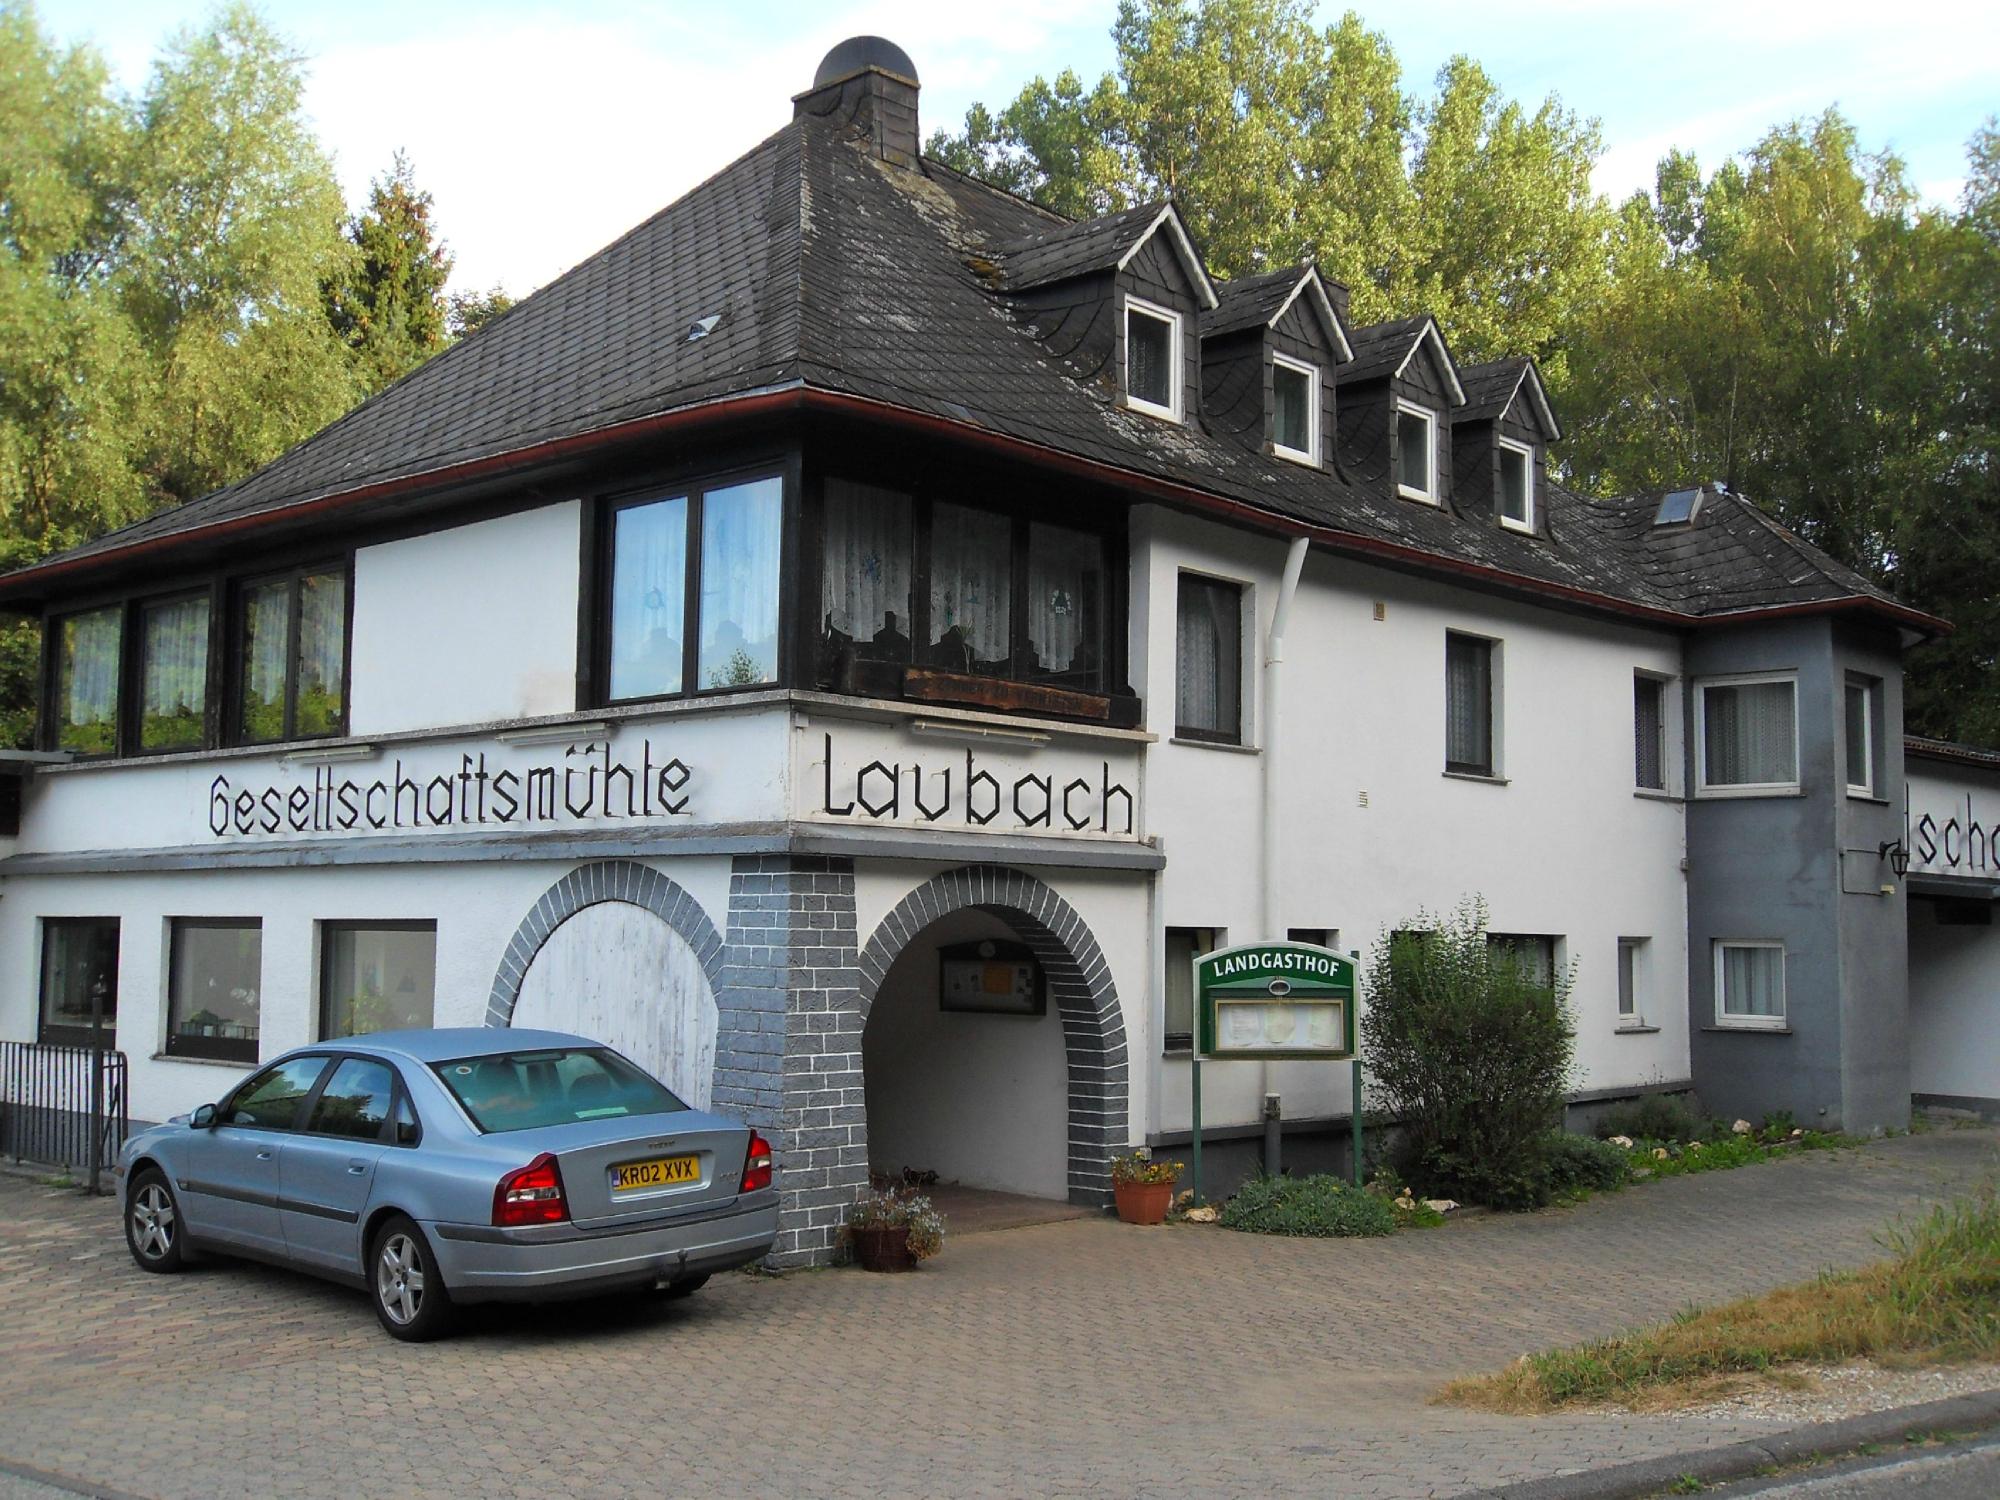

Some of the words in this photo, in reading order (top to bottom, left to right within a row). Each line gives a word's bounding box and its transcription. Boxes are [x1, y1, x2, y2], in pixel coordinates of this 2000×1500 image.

[209, 738, 692, 836] Gesellschaftsmühle
[825, 732, 1133, 835] Laubach
[1213, 952, 1340, 978] LANDGASTHOF
[619, 1164, 660, 1186] KR02
[663, 1159, 693, 1180] XVX
